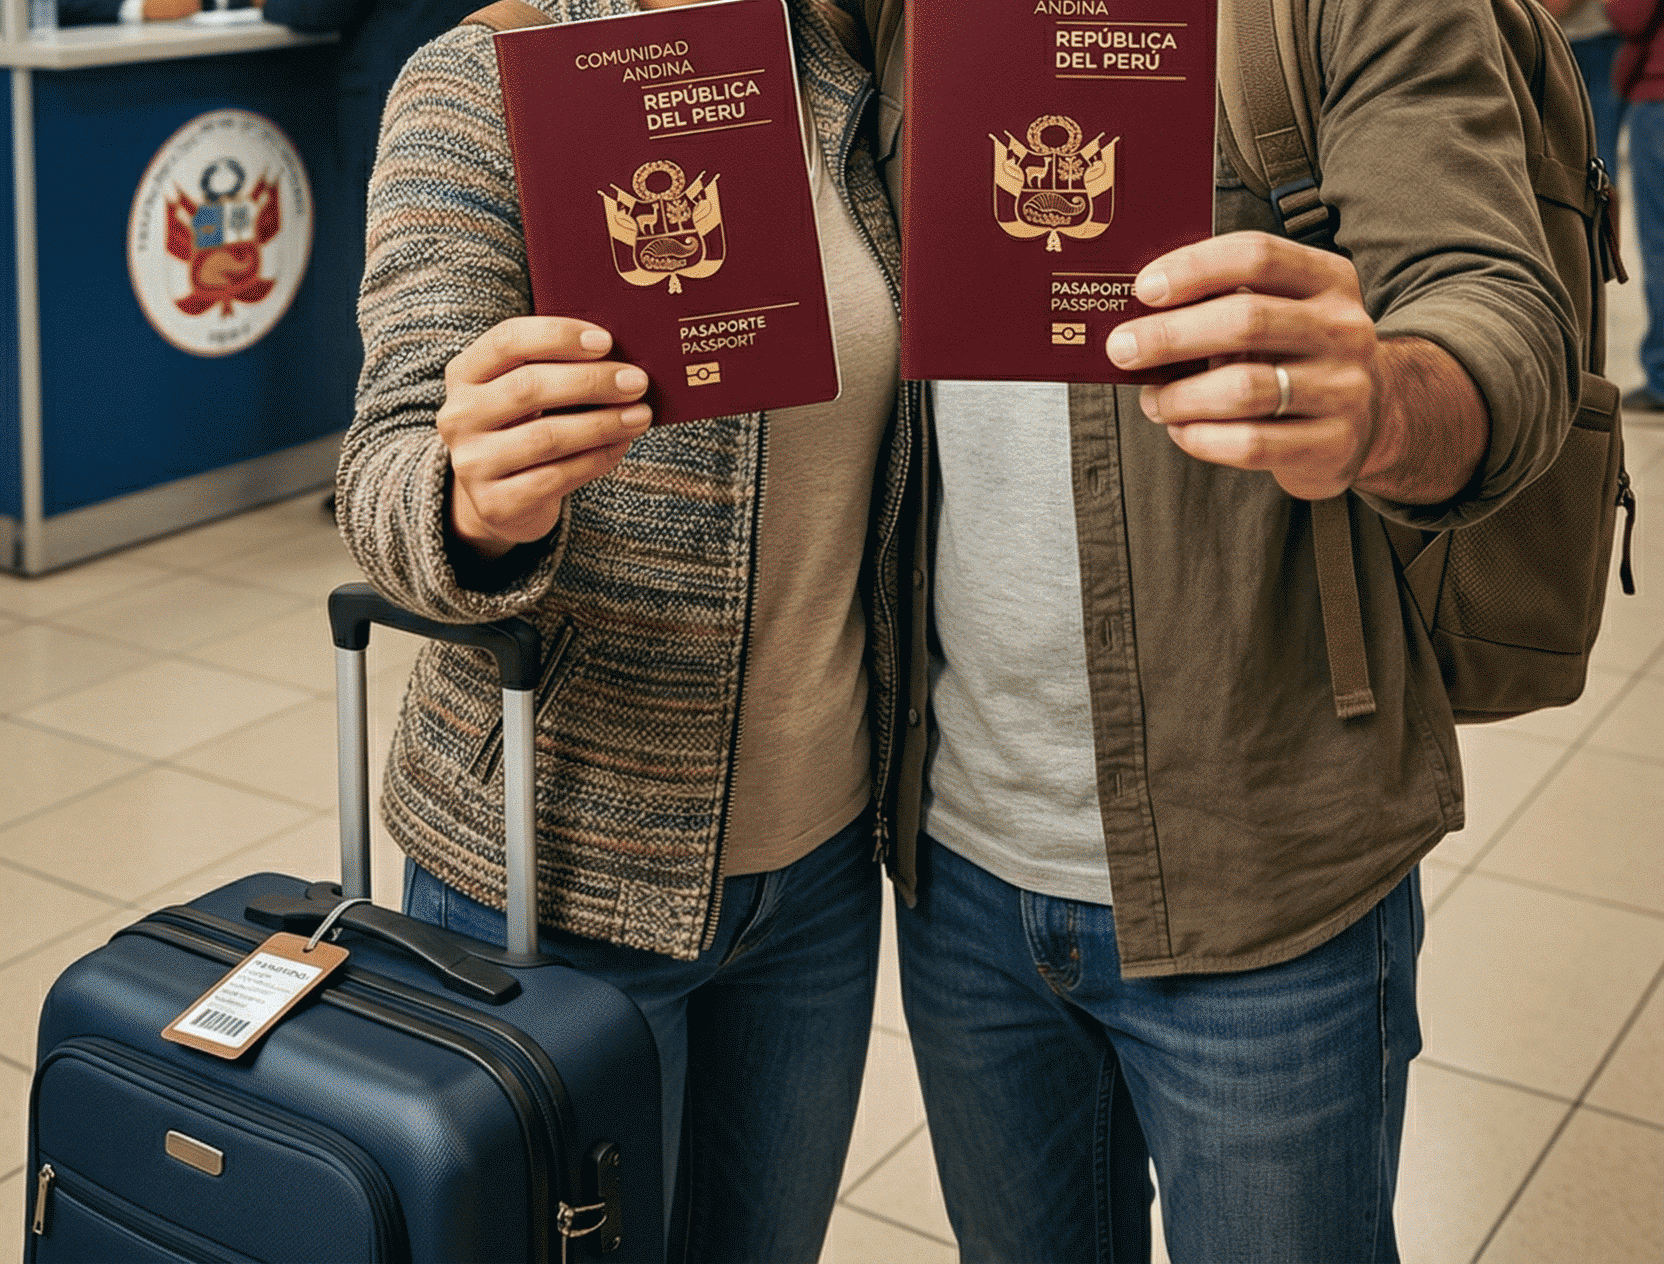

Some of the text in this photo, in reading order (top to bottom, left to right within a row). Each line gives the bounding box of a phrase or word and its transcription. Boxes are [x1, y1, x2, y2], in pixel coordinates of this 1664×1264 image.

[1034, 0, 1109, 15] ANDINA
[1055, 27, 1178, 50] REPÚBLICA
[575, 40, 689, 70] COMUNIDAD
[1055, 49, 1160, 71] DEL PERÚ
[622, 59, 695, 83] ANDINA
[643, 79, 761, 111] REPÚBLICA
[646, 102, 746, 131] DEL PERU
[1051, 298, 1128, 311] PASSPORT
[680, 315, 767, 340] PASAPORTE
[682, 332, 757, 354] PASSPORT
